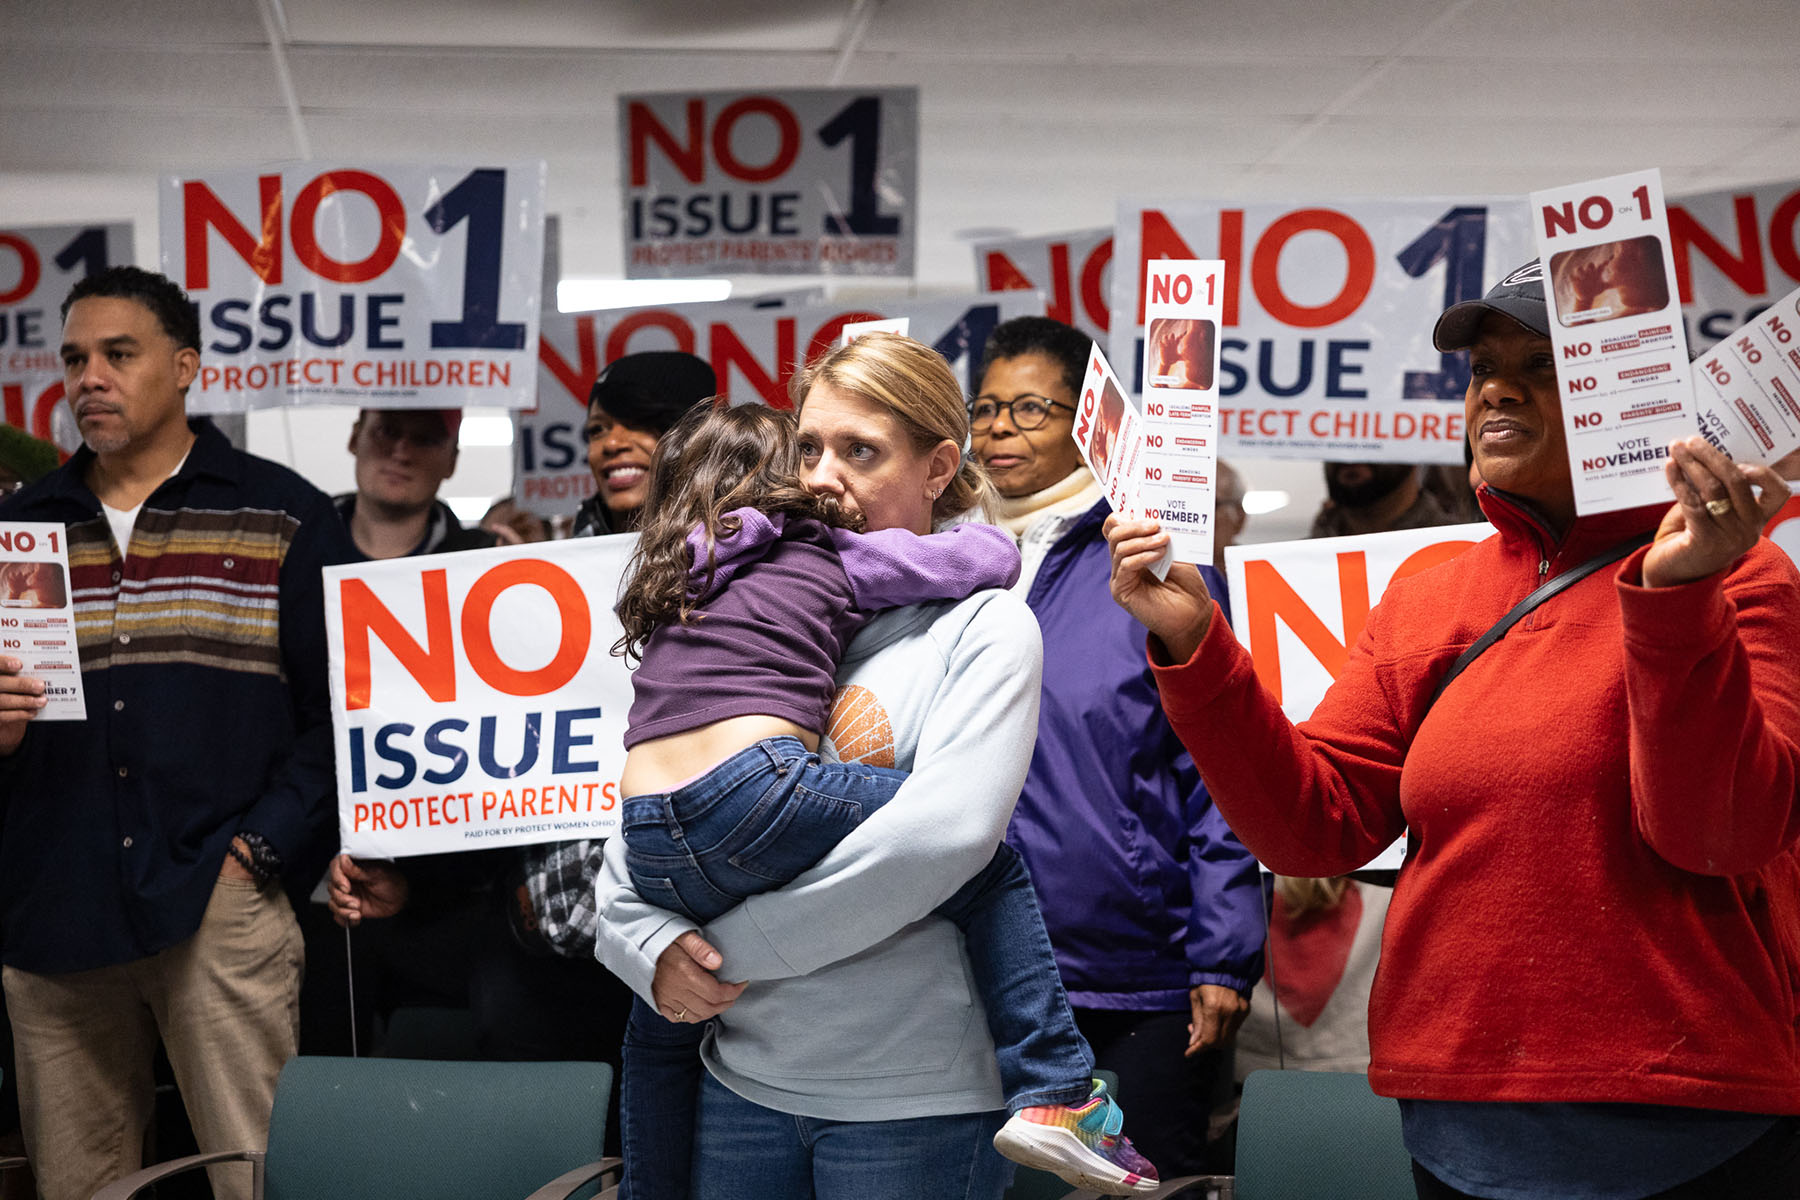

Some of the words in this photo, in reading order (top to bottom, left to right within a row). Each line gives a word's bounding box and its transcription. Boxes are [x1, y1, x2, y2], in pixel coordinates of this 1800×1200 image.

[627, 96, 803, 187] NO
[816, 96, 901, 235] 1
[632, 191, 801, 239] ISSUE
[1542, 195, 1614, 238] NO
[1632, 185, 1652, 221] 1
[183, 169, 407, 292] NO
[424, 168, 526, 350] 1
[1137, 208, 1376, 328] NO
[1396, 206, 1488, 400] 1
[1152, 273, 1193, 305] NO
[1206, 273, 1216, 306] 1
[1766, 315, 1792, 343] NO
[1563, 342, 1592, 359] NO
[1736, 336, 1762, 364] NO
[202, 359, 345, 392] PROTECT
[352, 361, 511, 388] CHILDREN
[1568, 376, 1597, 394] NO
[1705, 357, 1731, 386] NO
[1076, 388, 1095, 447] NO
[1093, 356, 1103, 377] 1
[1147, 403, 1164, 416] NO
[1218, 408, 1301, 438] TECT
[1309, 411, 1464, 442] CHILDRE
[1574, 412, 1603, 429] NO
[1706, 408, 1730, 439] VOTE
[1146, 435, 1163, 448] NO
[1617, 436, 1651, 451] VOTE
[1145, 467, 1162, 480] NO
[1145, 508, 1199, 523] NOVEMBER
[1202, 514, 1208, 524] 7
[1167, 499, 1186, 509] VOTE
[48, 531, 59, 553] 1
[1, 618, 19, 627] NO
[340, 558, 592, 711] NO
[3, 639, 21, 648] NO
[70, 687, 76, 695] 7
[349, 706, 602, 793] ISSUE
[354, 792, 474, 833] PROTECT
[482, 782, 616, 821] PARENTS
[464, 830, 483, 839] PAID
[484, 829, 500, 837] FOR
[502, 827, 513, 835] BY
[515, 824, 551, 833] PROTECT
[553, 821, 589, 830] WOMEN
[591, 819, 616, 828] OHIO
